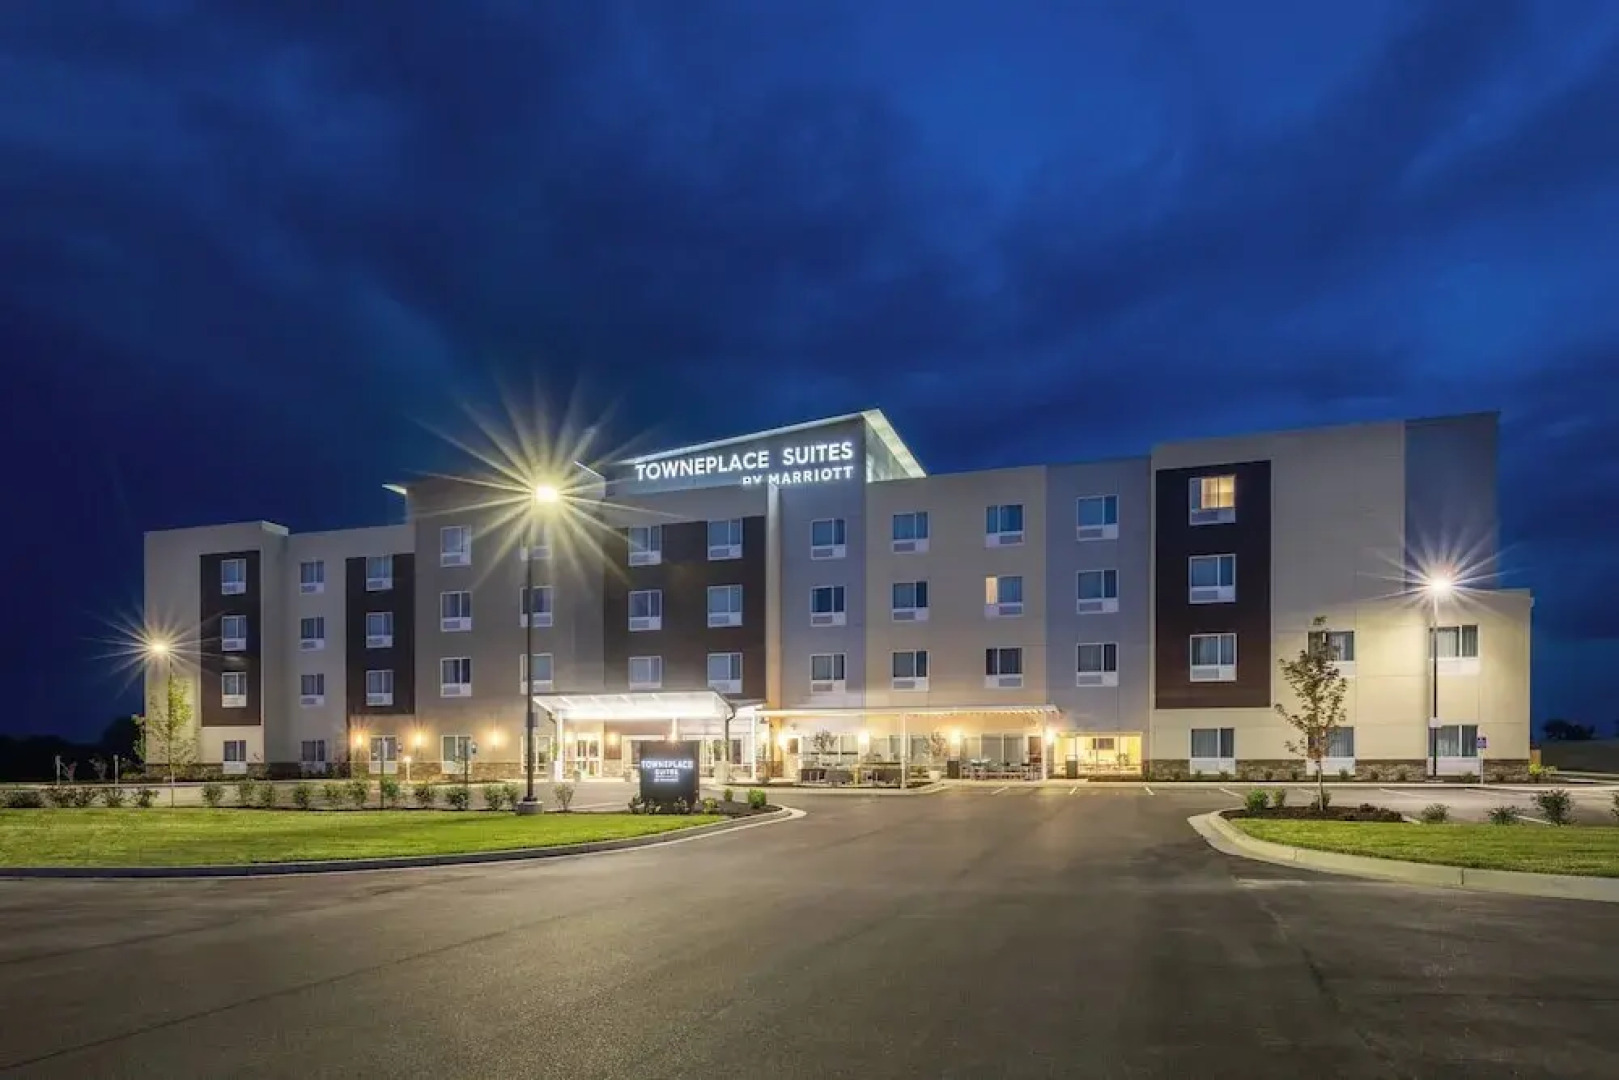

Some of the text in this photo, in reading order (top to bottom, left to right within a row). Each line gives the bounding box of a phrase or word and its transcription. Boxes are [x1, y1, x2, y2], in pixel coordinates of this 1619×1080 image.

[635, 442, 853, 481] TOWNEPLACE SUITES
[768, 466, 854, 485] MARRIOTT
